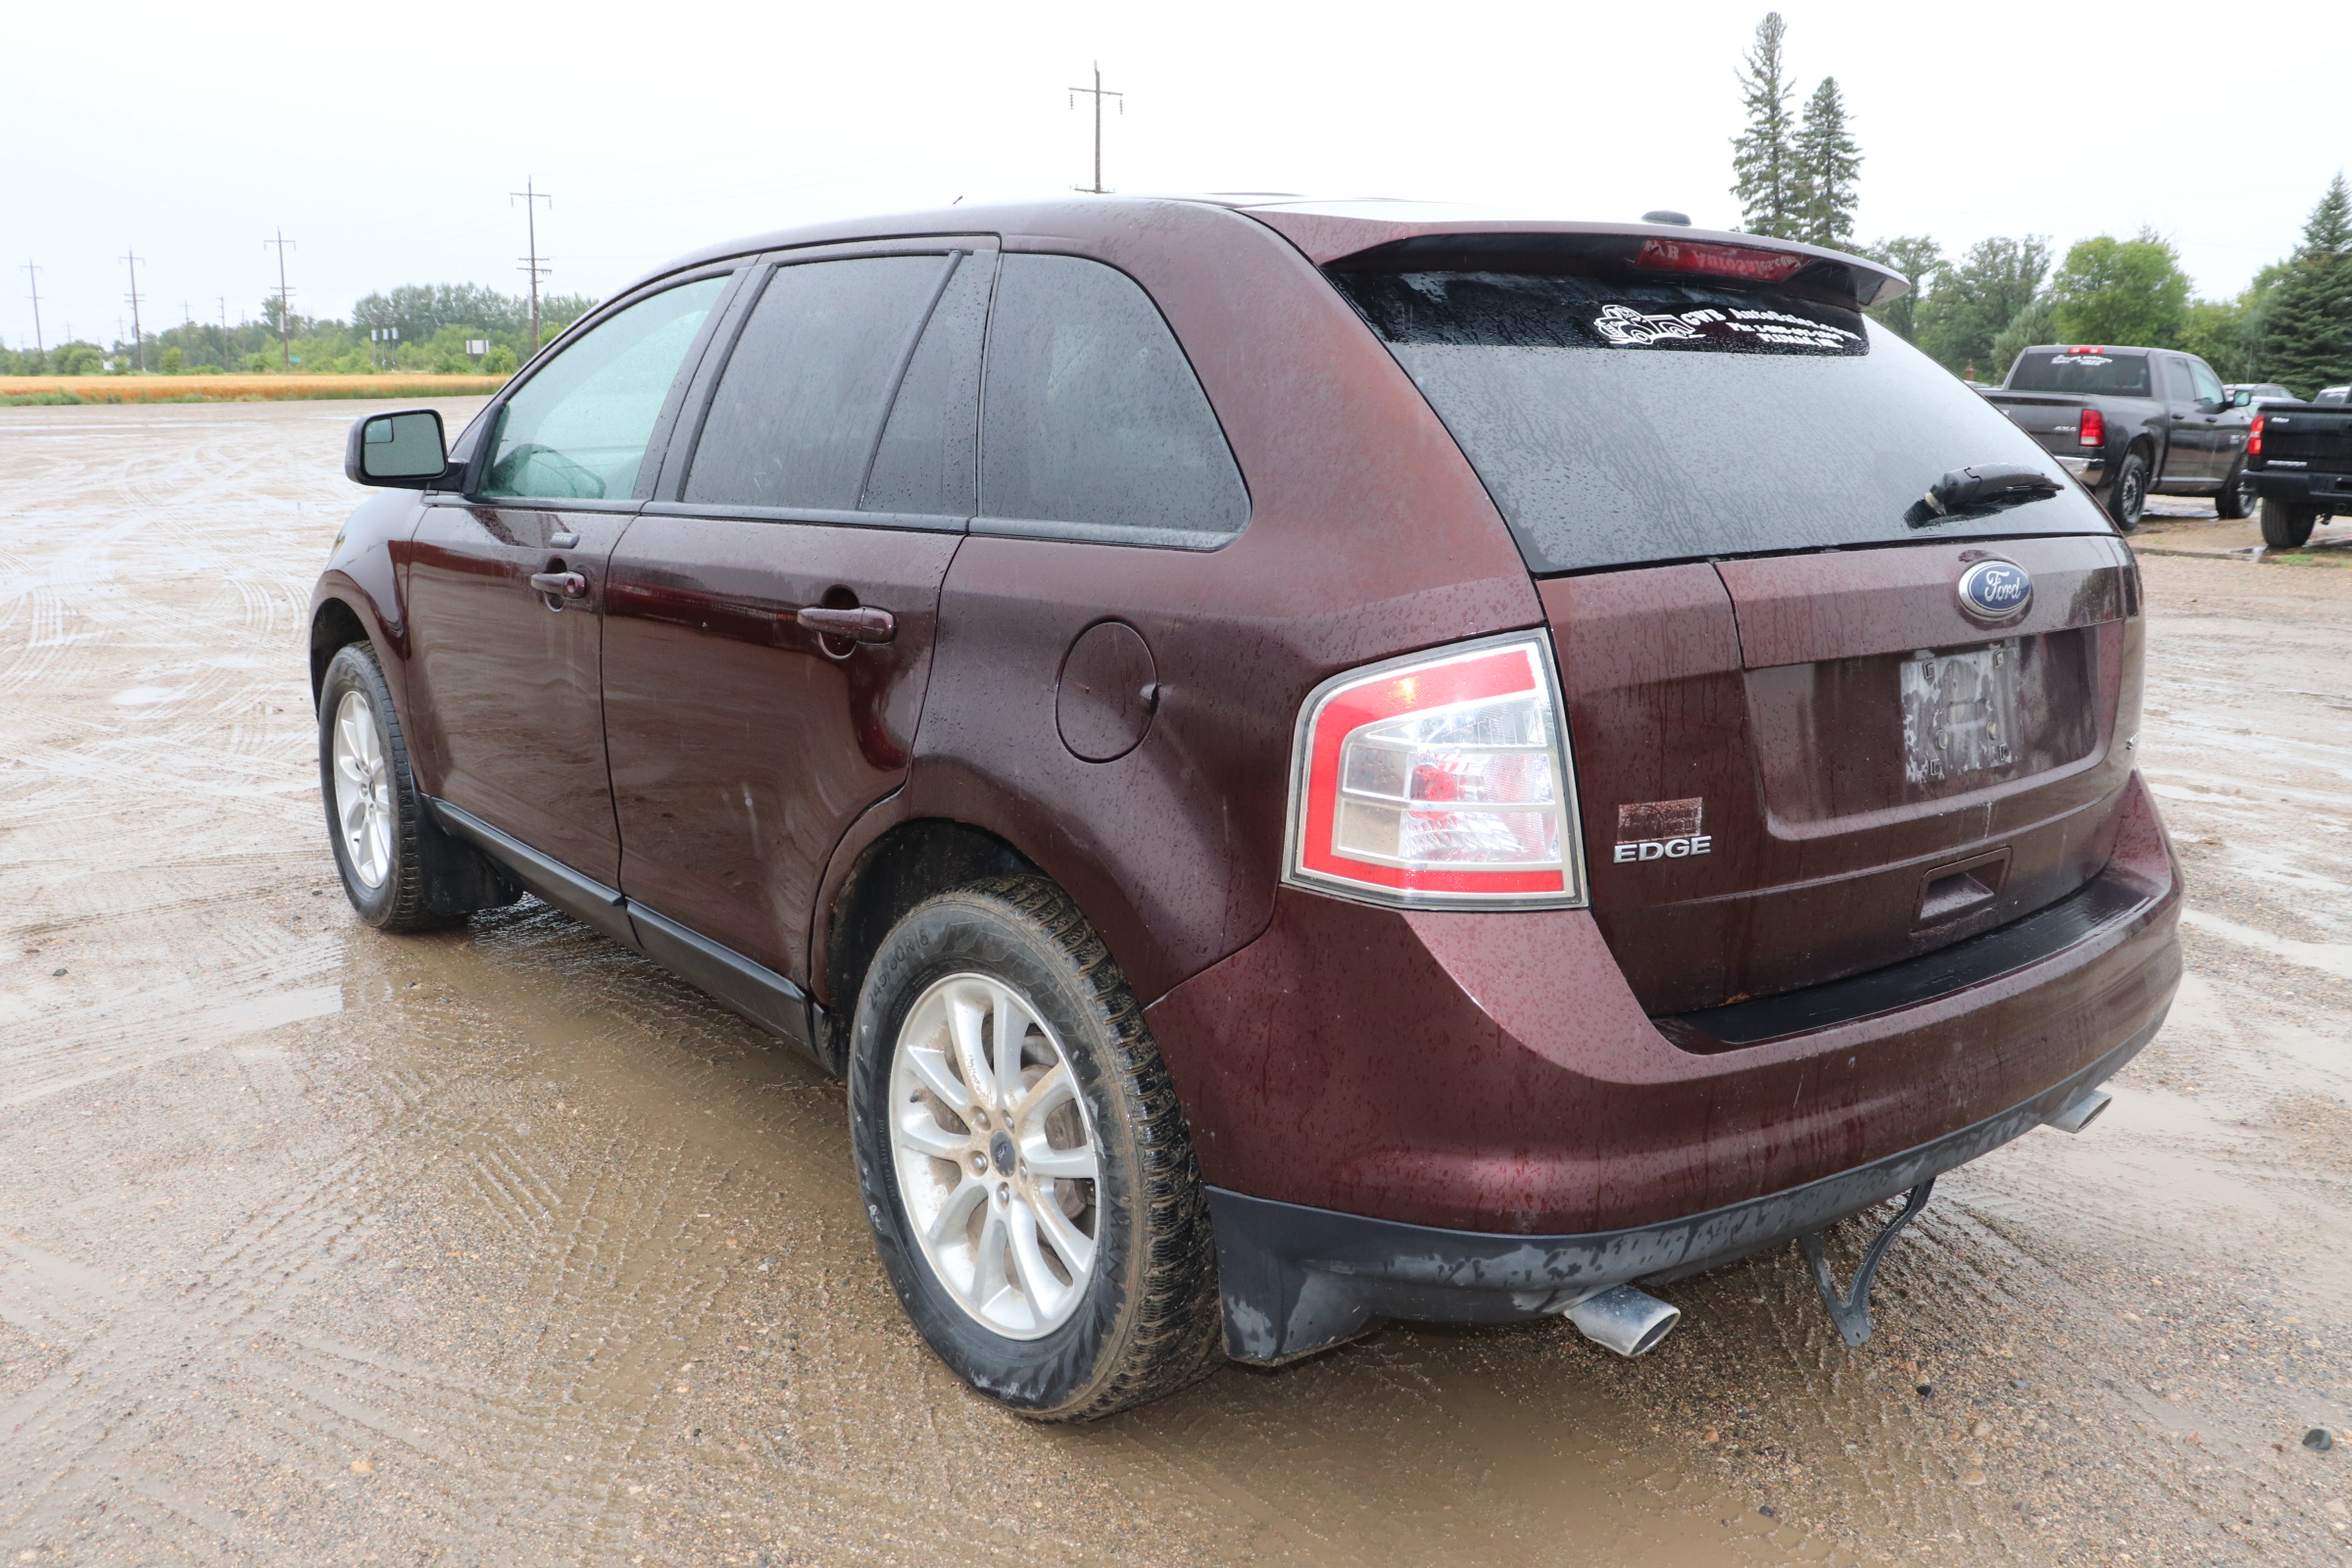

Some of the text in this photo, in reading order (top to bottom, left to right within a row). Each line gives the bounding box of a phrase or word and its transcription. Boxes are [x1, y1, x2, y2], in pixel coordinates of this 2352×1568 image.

[1680, 308, 1862, 341] GWB AutoSales.com
[1984, 570, 2021, 602] Ford
[1613, 835, 1712, 863] EDGE
